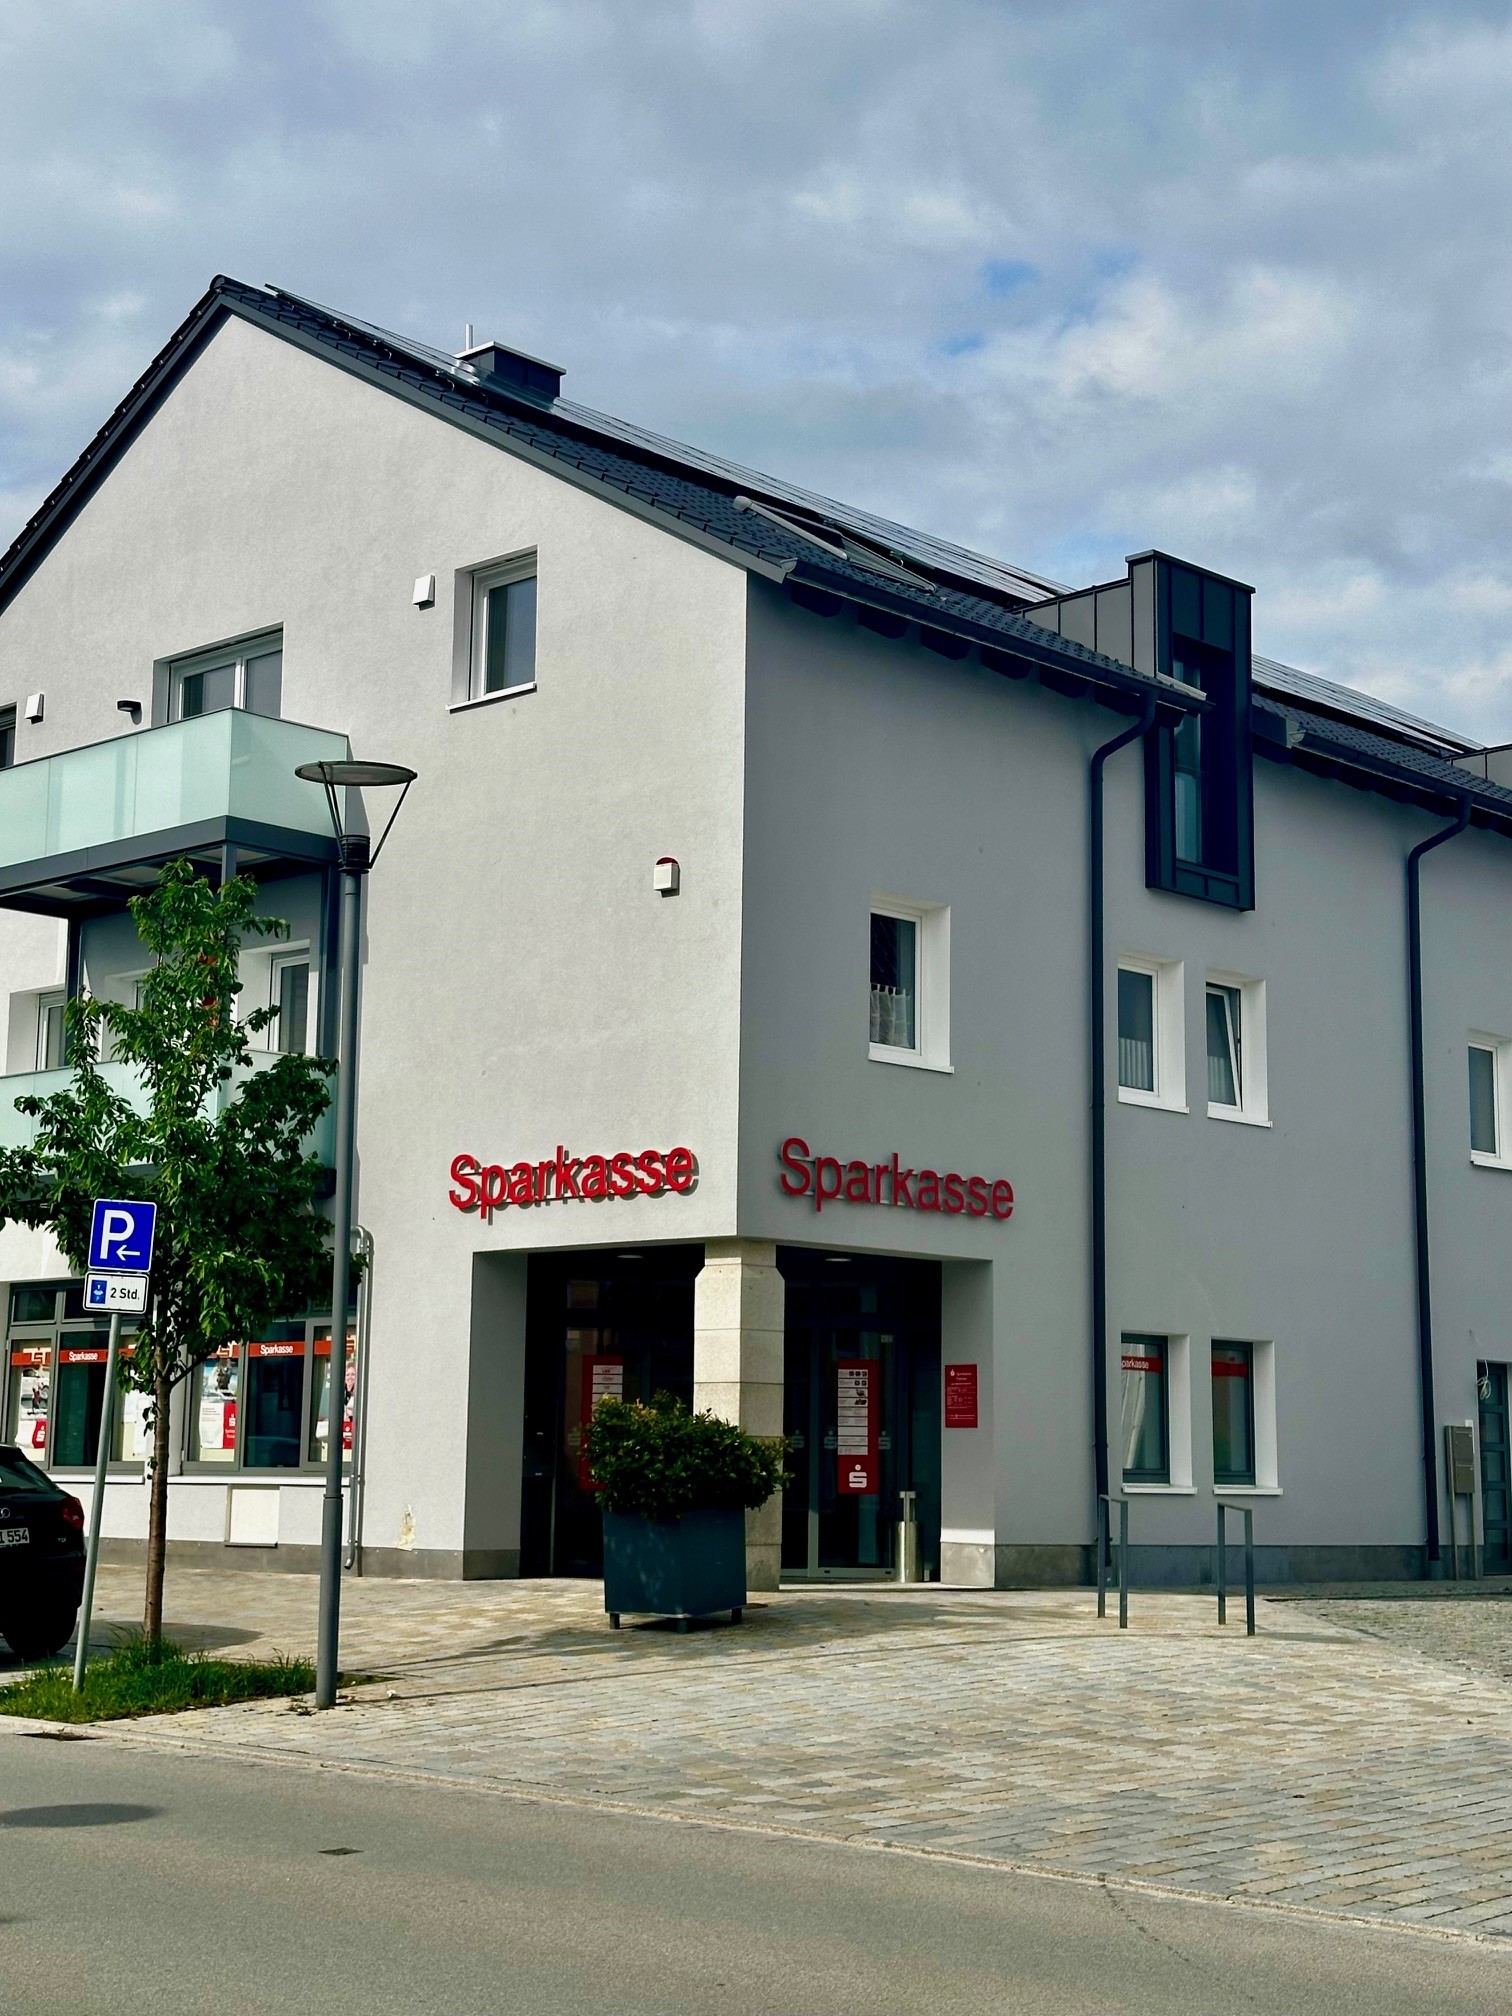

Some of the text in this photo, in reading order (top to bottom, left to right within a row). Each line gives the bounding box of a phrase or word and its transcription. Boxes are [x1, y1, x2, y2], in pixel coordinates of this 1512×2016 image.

[449, 1145, 694, 1219] Sparkasse
[783, 1137, 1014, 1220] Sparkasse
[100, 1209, 135, 1259] P
[110, 1287, 140, 1300] 2 Std.
[68, 1351, 99, 1362] Sparkasse
[260, 1344, 294, 1356] Sparkasse
[7, 1529, 28, 1543] 554
